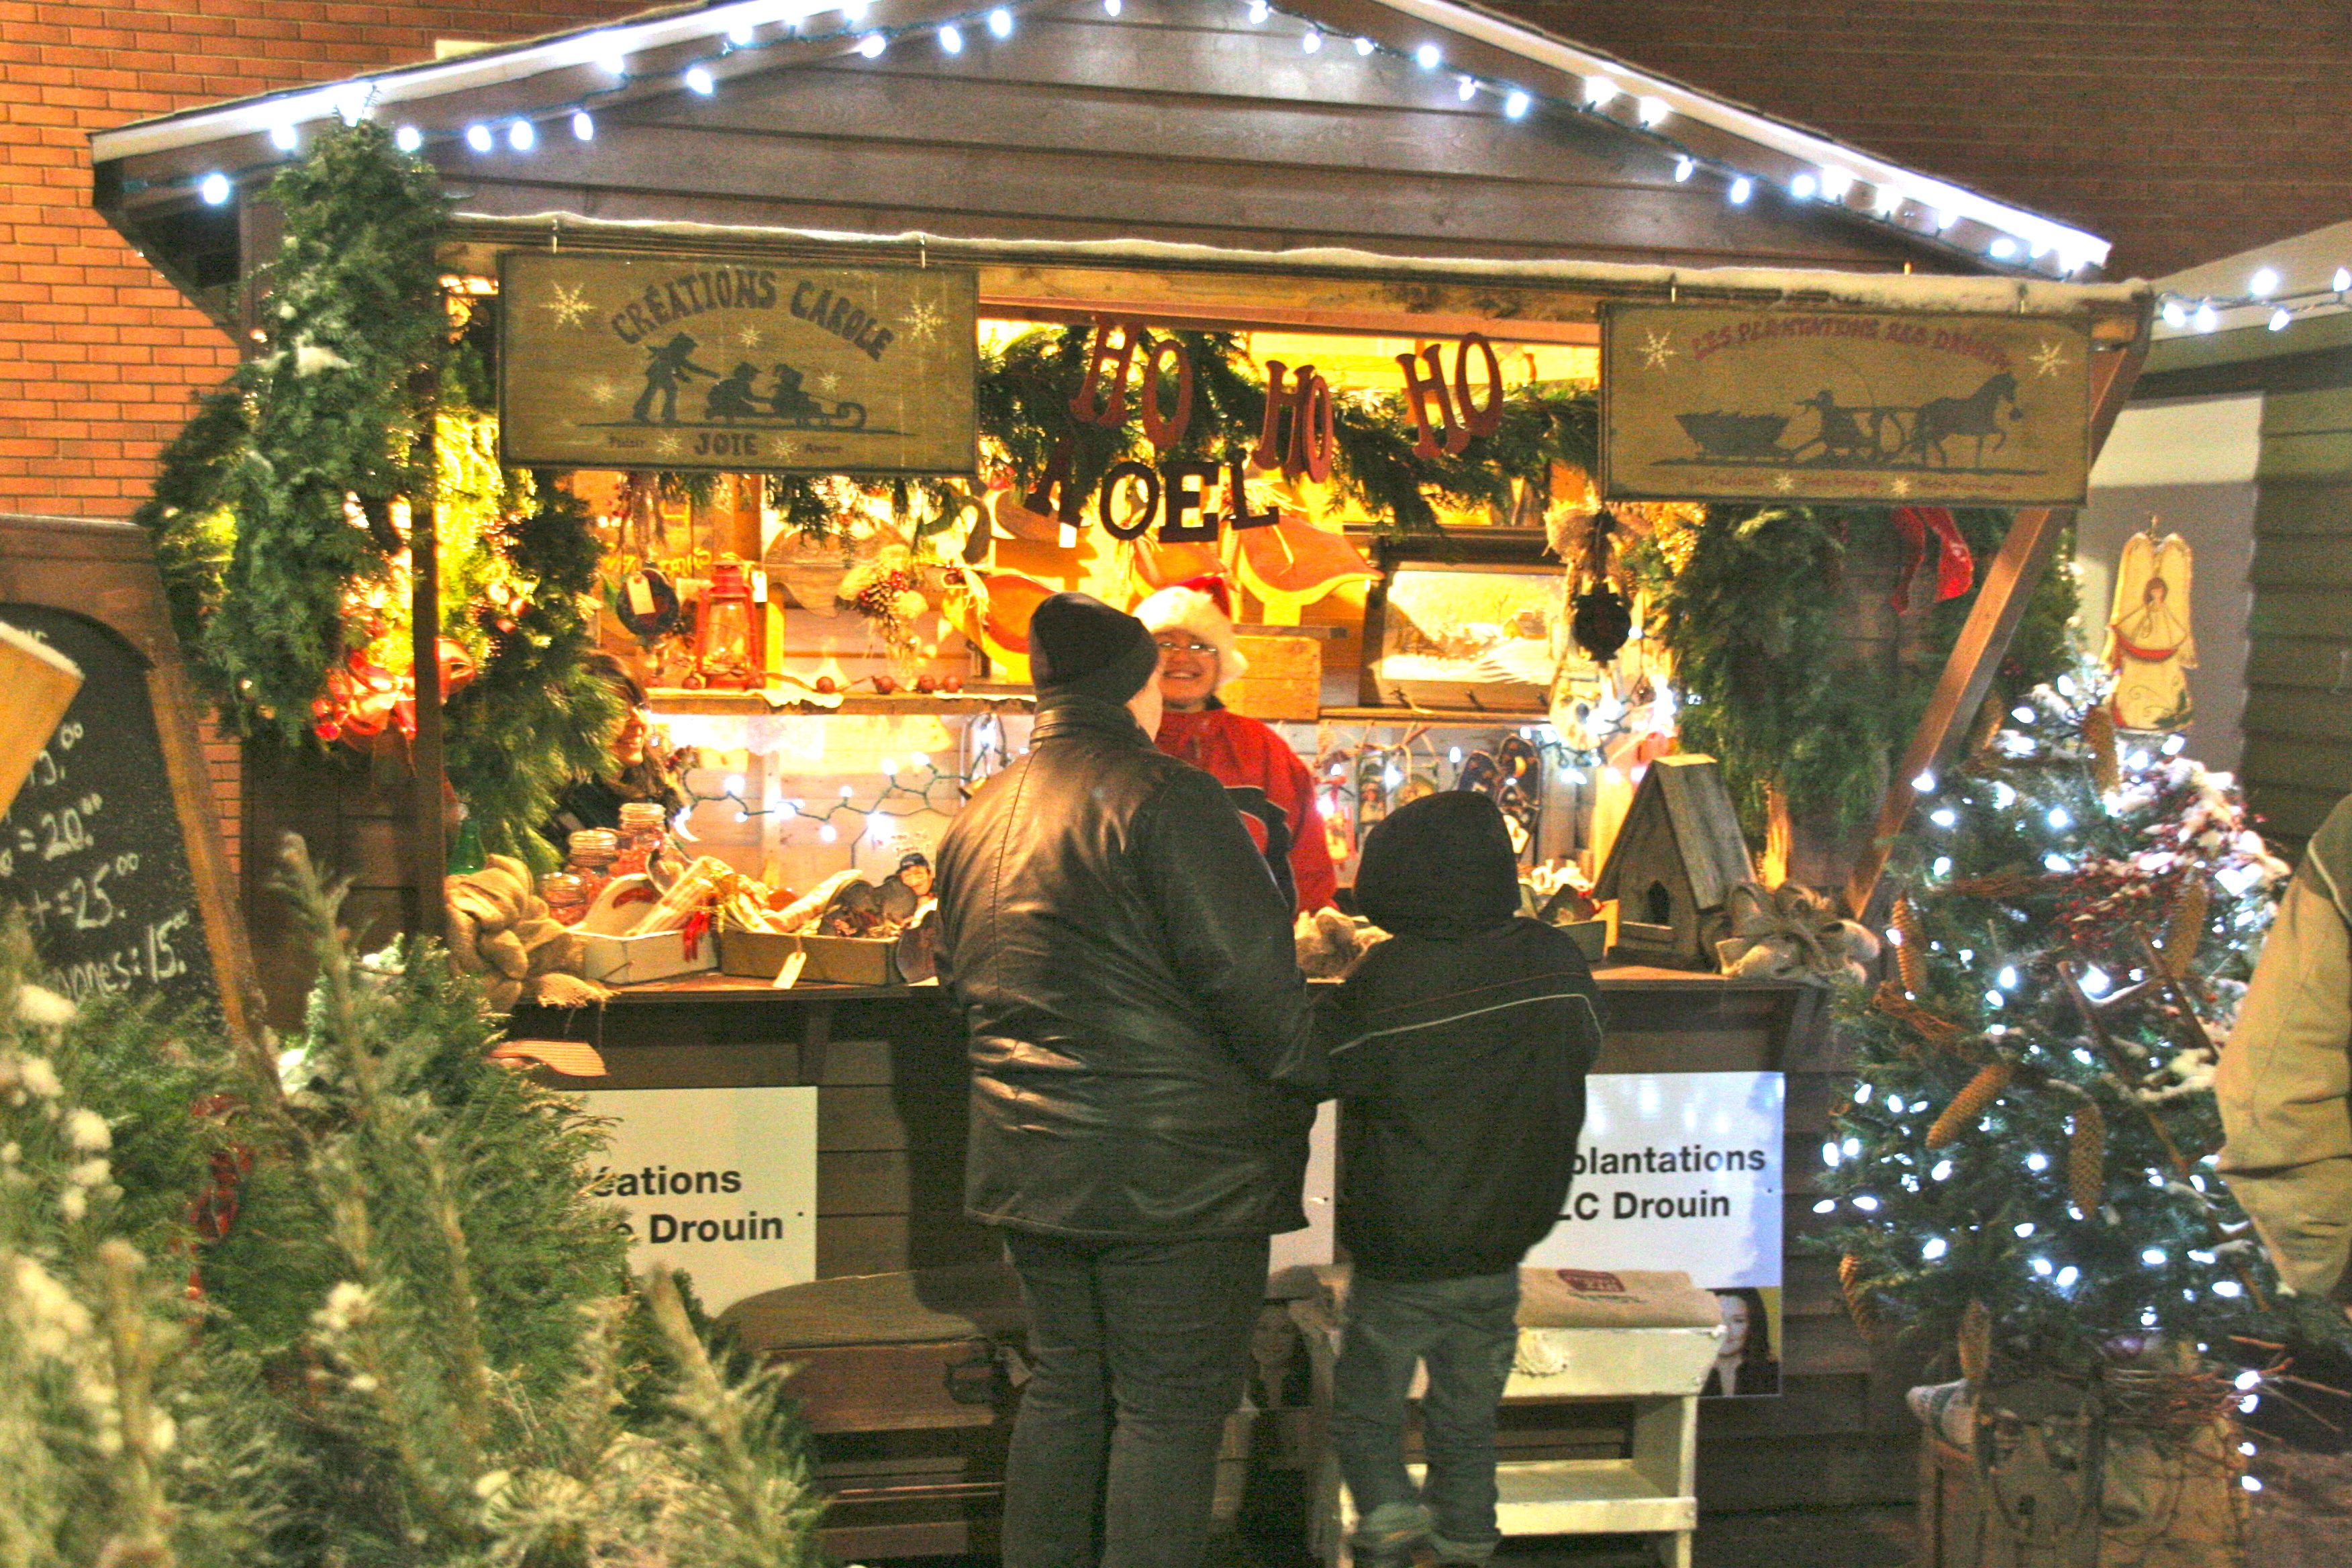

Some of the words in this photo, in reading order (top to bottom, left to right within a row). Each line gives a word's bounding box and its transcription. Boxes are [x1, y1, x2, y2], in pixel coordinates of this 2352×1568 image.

[790, 280, 895, 362] CAROLE
[1069, 313, 1193, 450] HO
[1253, 360, 1334, 484] HO
[1395, 332, 1504, 460] HO
[693, 433, 758, 456] JOIE
[1614, 1189, 1730, 1220] Drouin
[650, 1210, 783, 1244] Drouin
